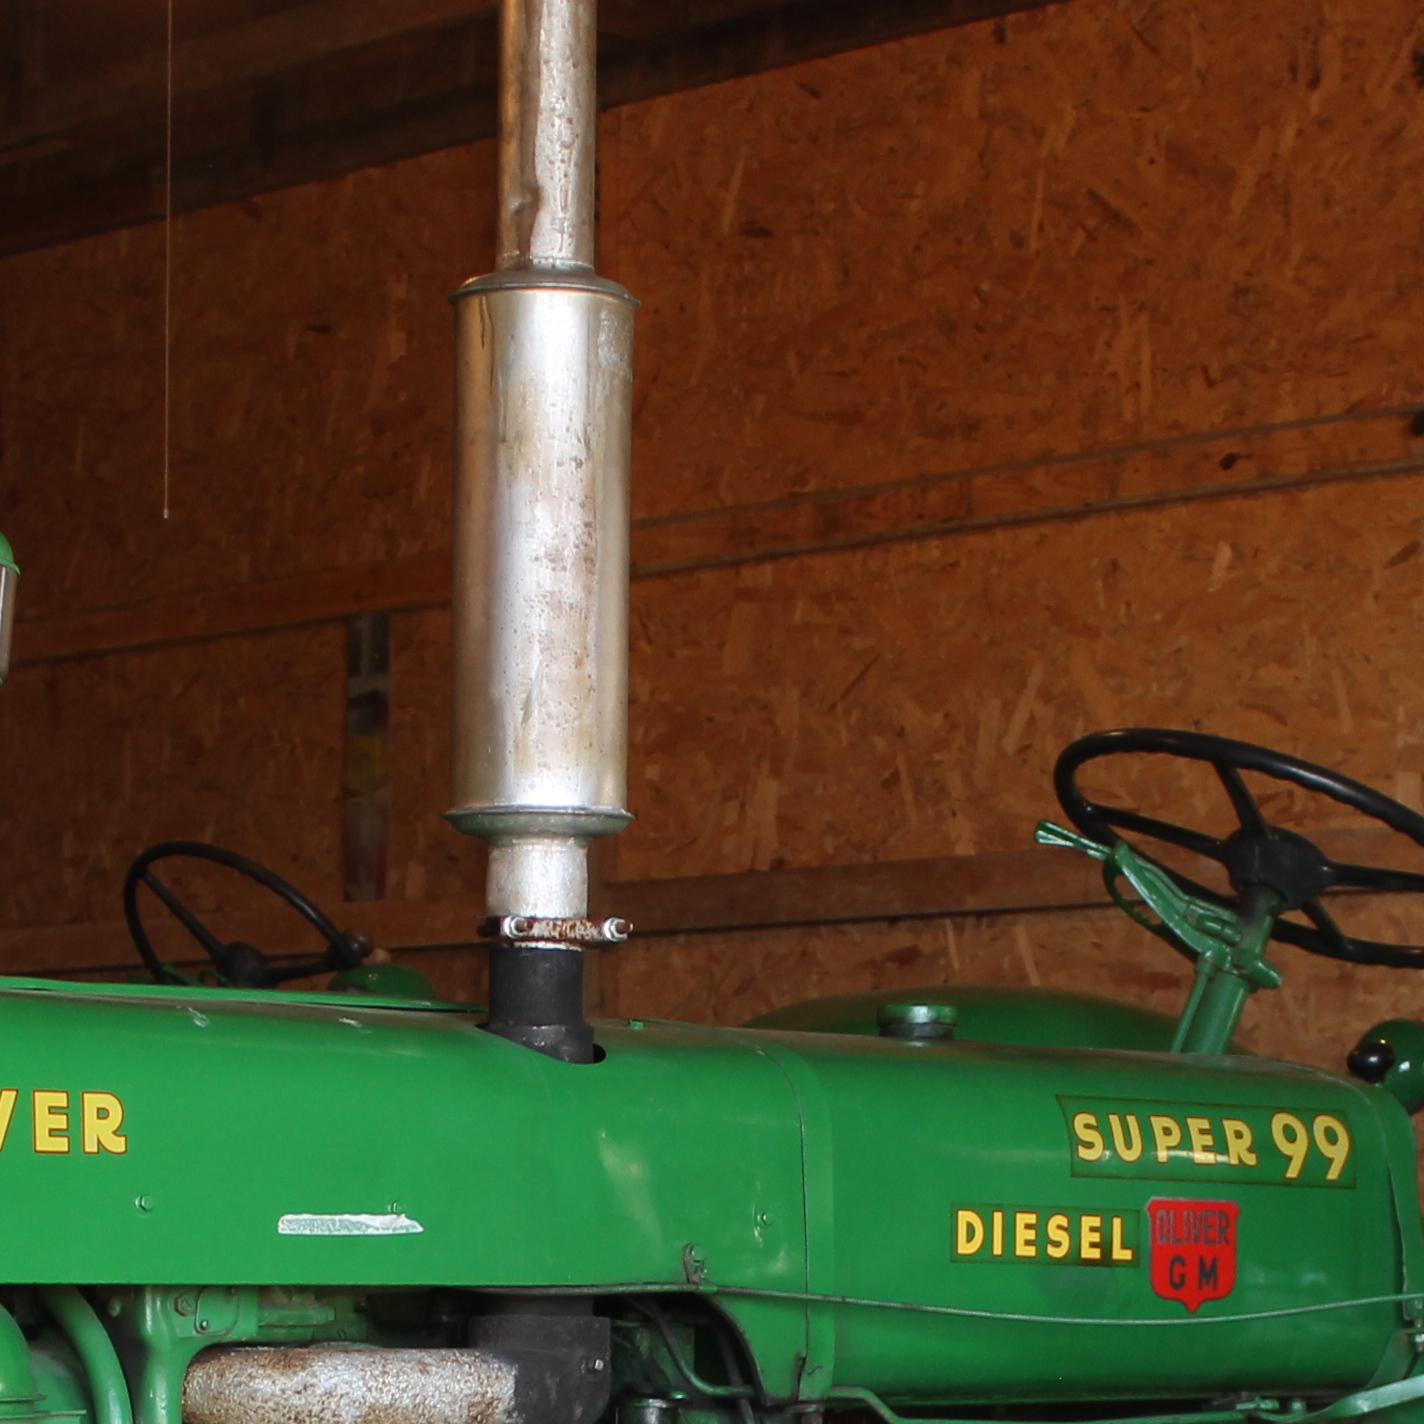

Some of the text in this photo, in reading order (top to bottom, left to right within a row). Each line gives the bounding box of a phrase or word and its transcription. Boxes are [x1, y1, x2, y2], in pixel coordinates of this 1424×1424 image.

[1073, 1111, 1351, 1181] SUPER 99
[956, 1209, 1133, 1261] DIESEL
[1157, 1210, 1230, 1245] OLIVER
